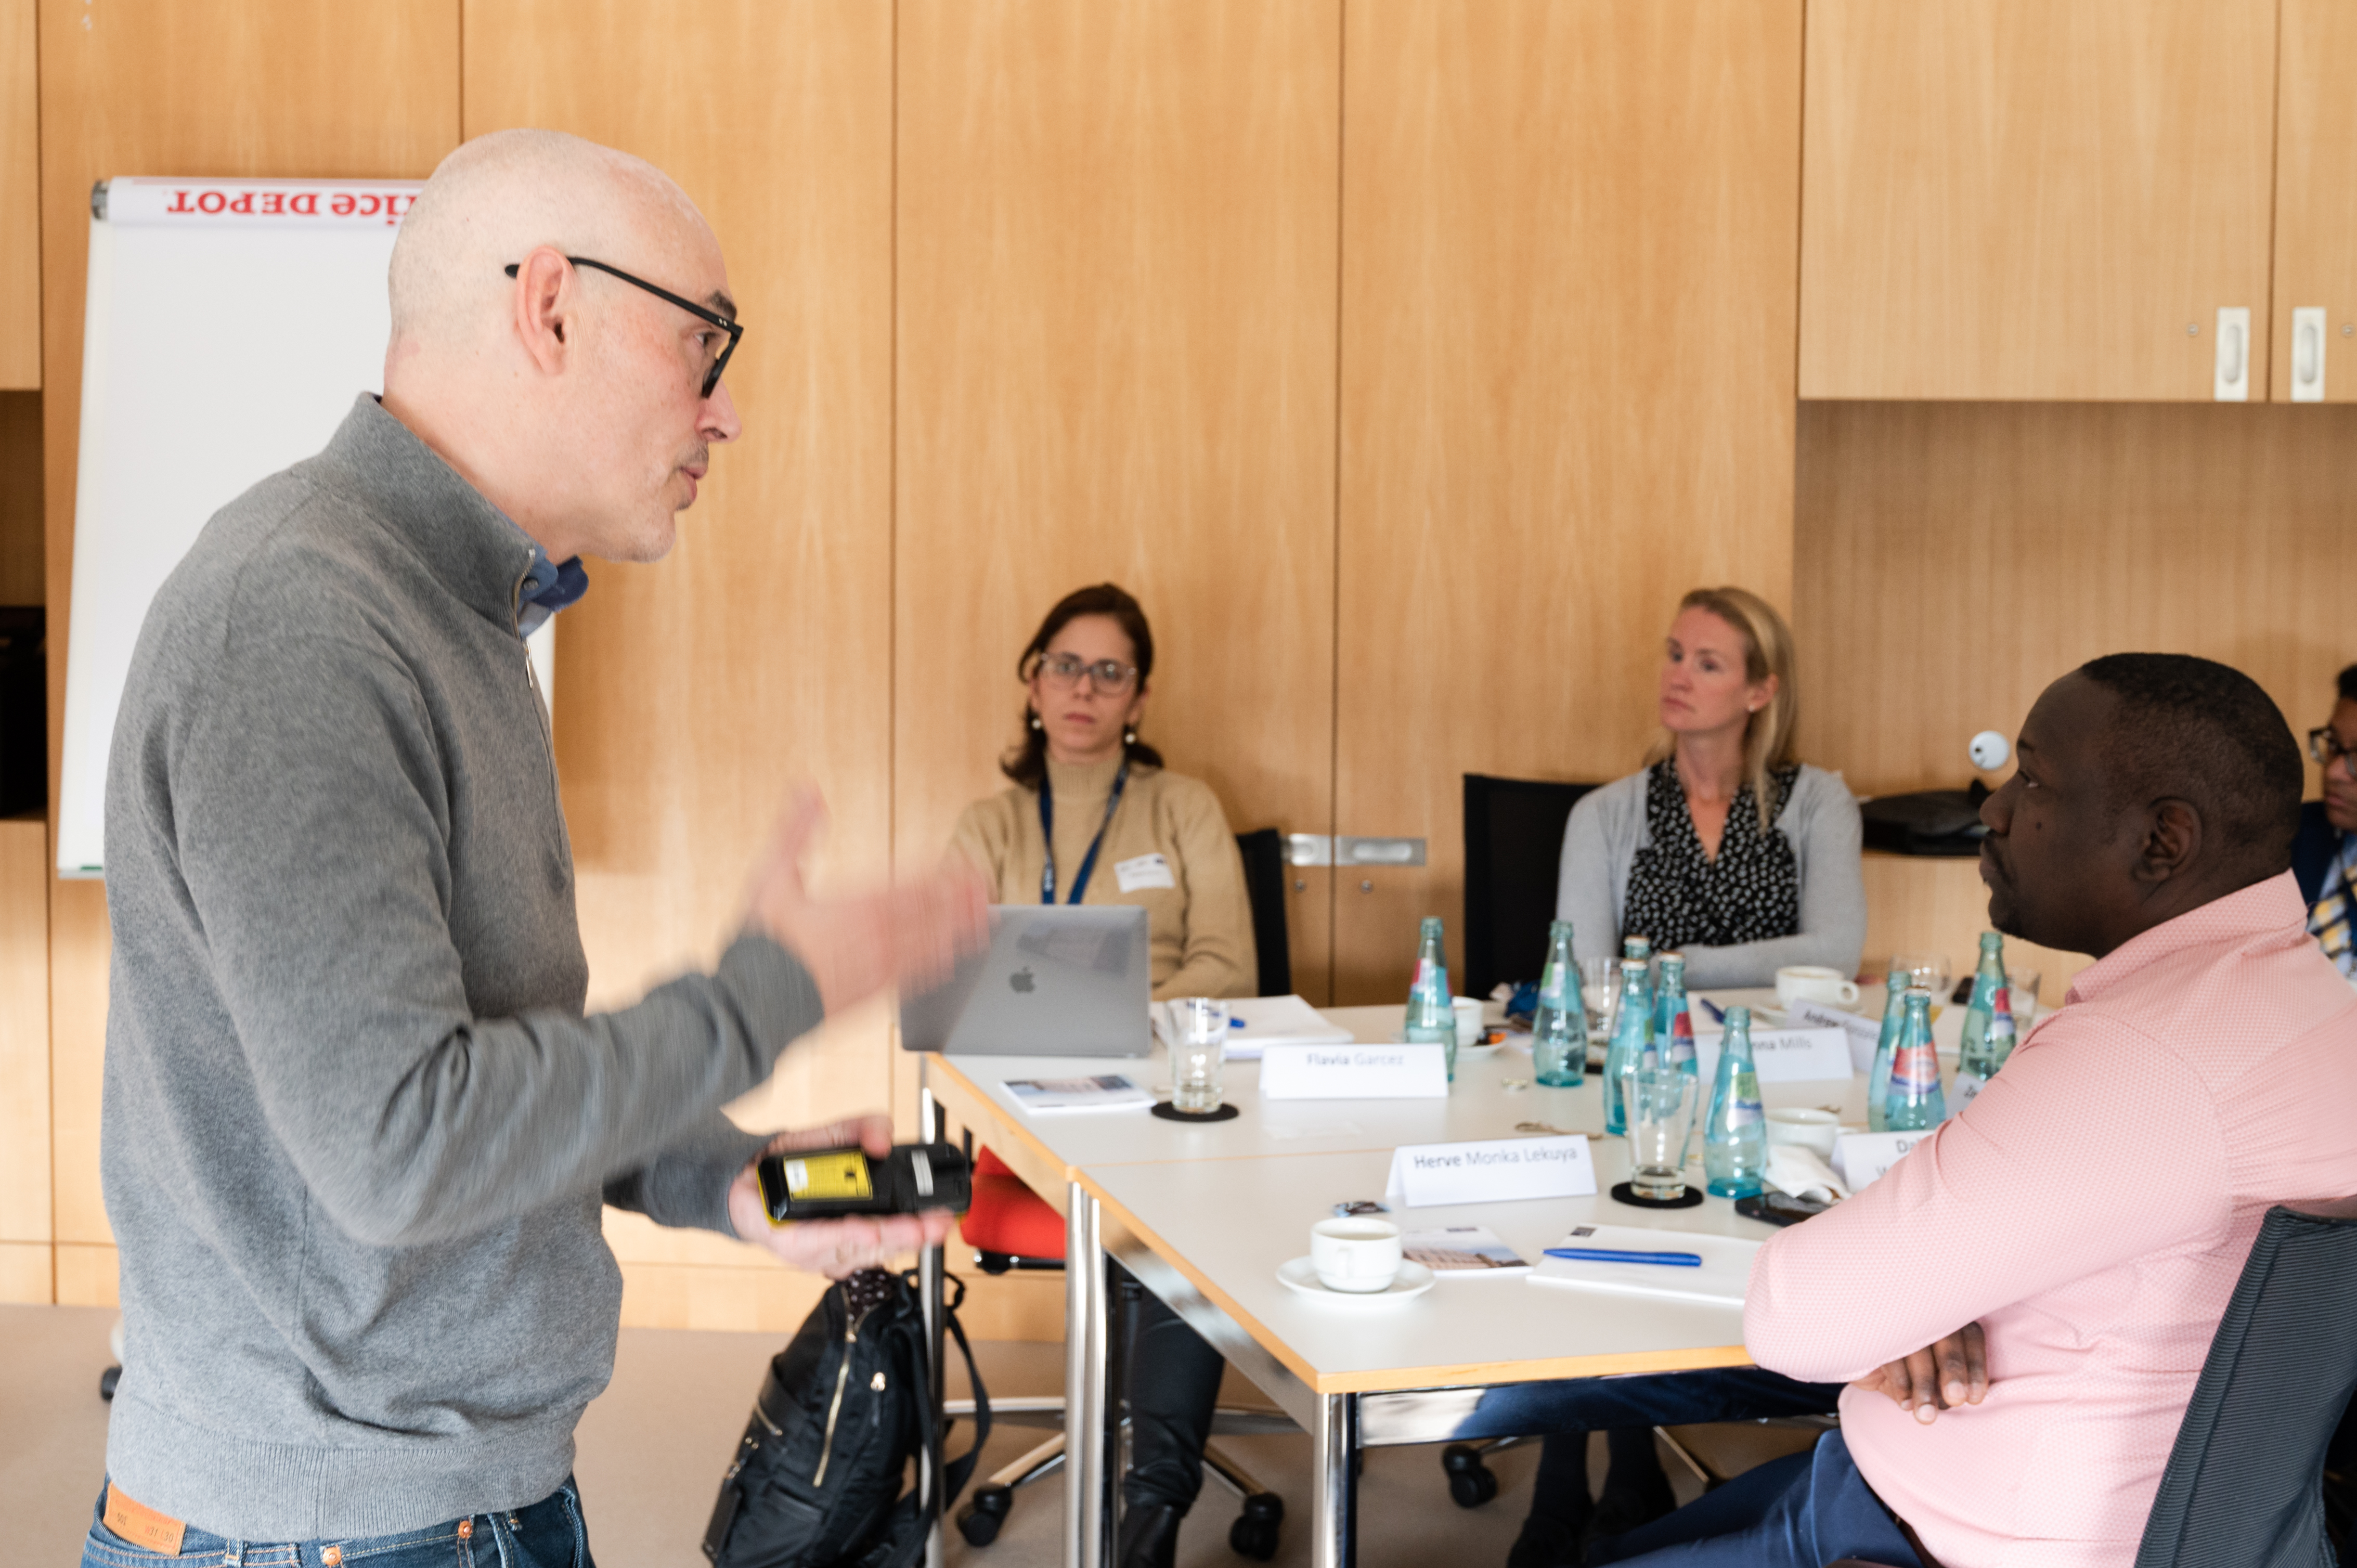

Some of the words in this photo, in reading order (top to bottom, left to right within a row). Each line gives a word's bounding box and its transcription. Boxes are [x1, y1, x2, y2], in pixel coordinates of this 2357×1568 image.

[167, 191, 320, 215] DEPOT
[1779, 1036, 1813, 1050] Mills
[1306, 1052, 1351, 1066] Flavia
[1353, 1052, 1404, 1067] Garcez
[1413, 1154, 1461, 1169] Herve
[1465, 1148, 1520, 1166] Monka
[1524, 1146, 1578, 1164] Lekuya
[145, 1524, 158, 1537] W31
[160, 1529, 174, 1543] L30
